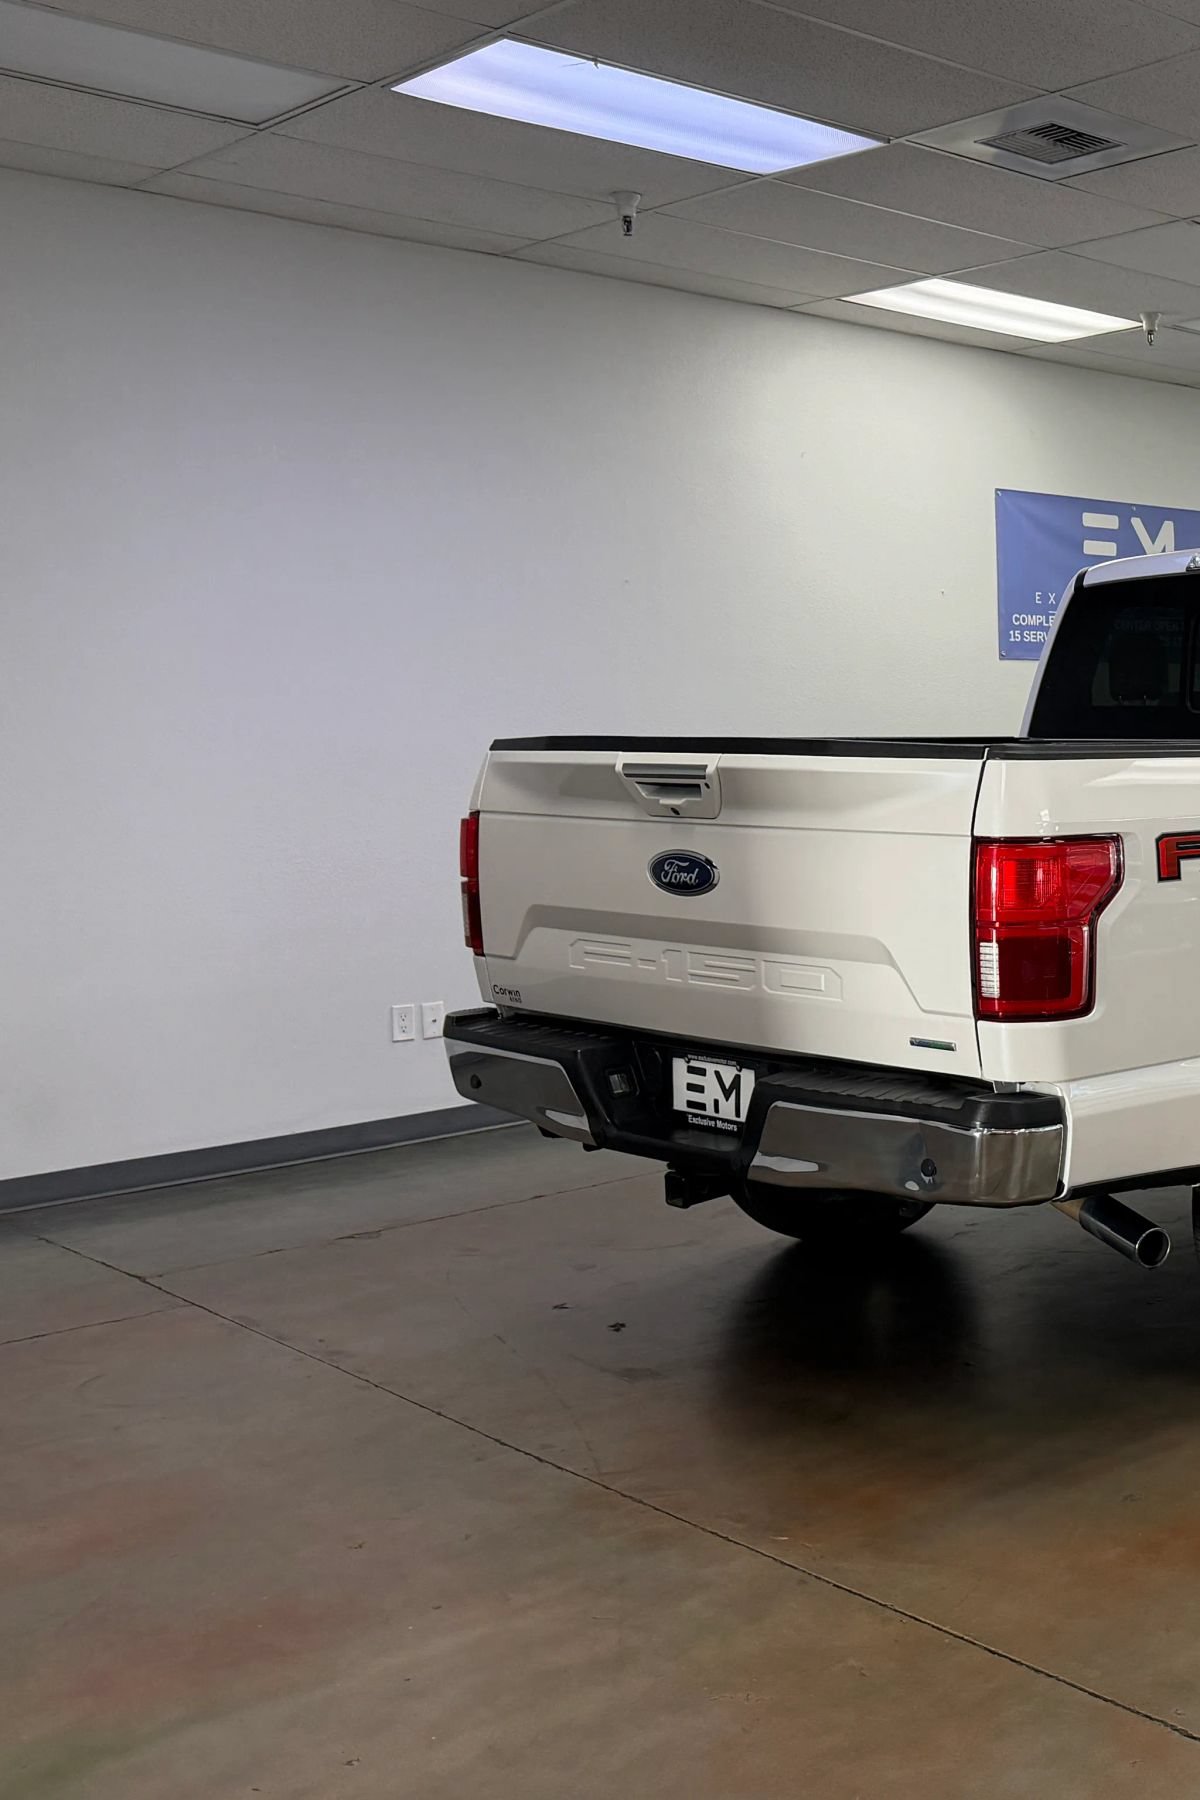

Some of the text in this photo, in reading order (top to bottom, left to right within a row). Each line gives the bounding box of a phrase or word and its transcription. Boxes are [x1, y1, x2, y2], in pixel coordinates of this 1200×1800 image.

[1012, 613, 1056, 627] COMPLE
[1009, 630, 1021, 642] 15
[661, 859, 699, 886] Ford
[569, 938, 843, 1002] F-150
[493, 984, 520, 999] Corwin
[686, 1065, 741, 1118] EM
[688, 1114, 738, 1132] Exclusive Motors
